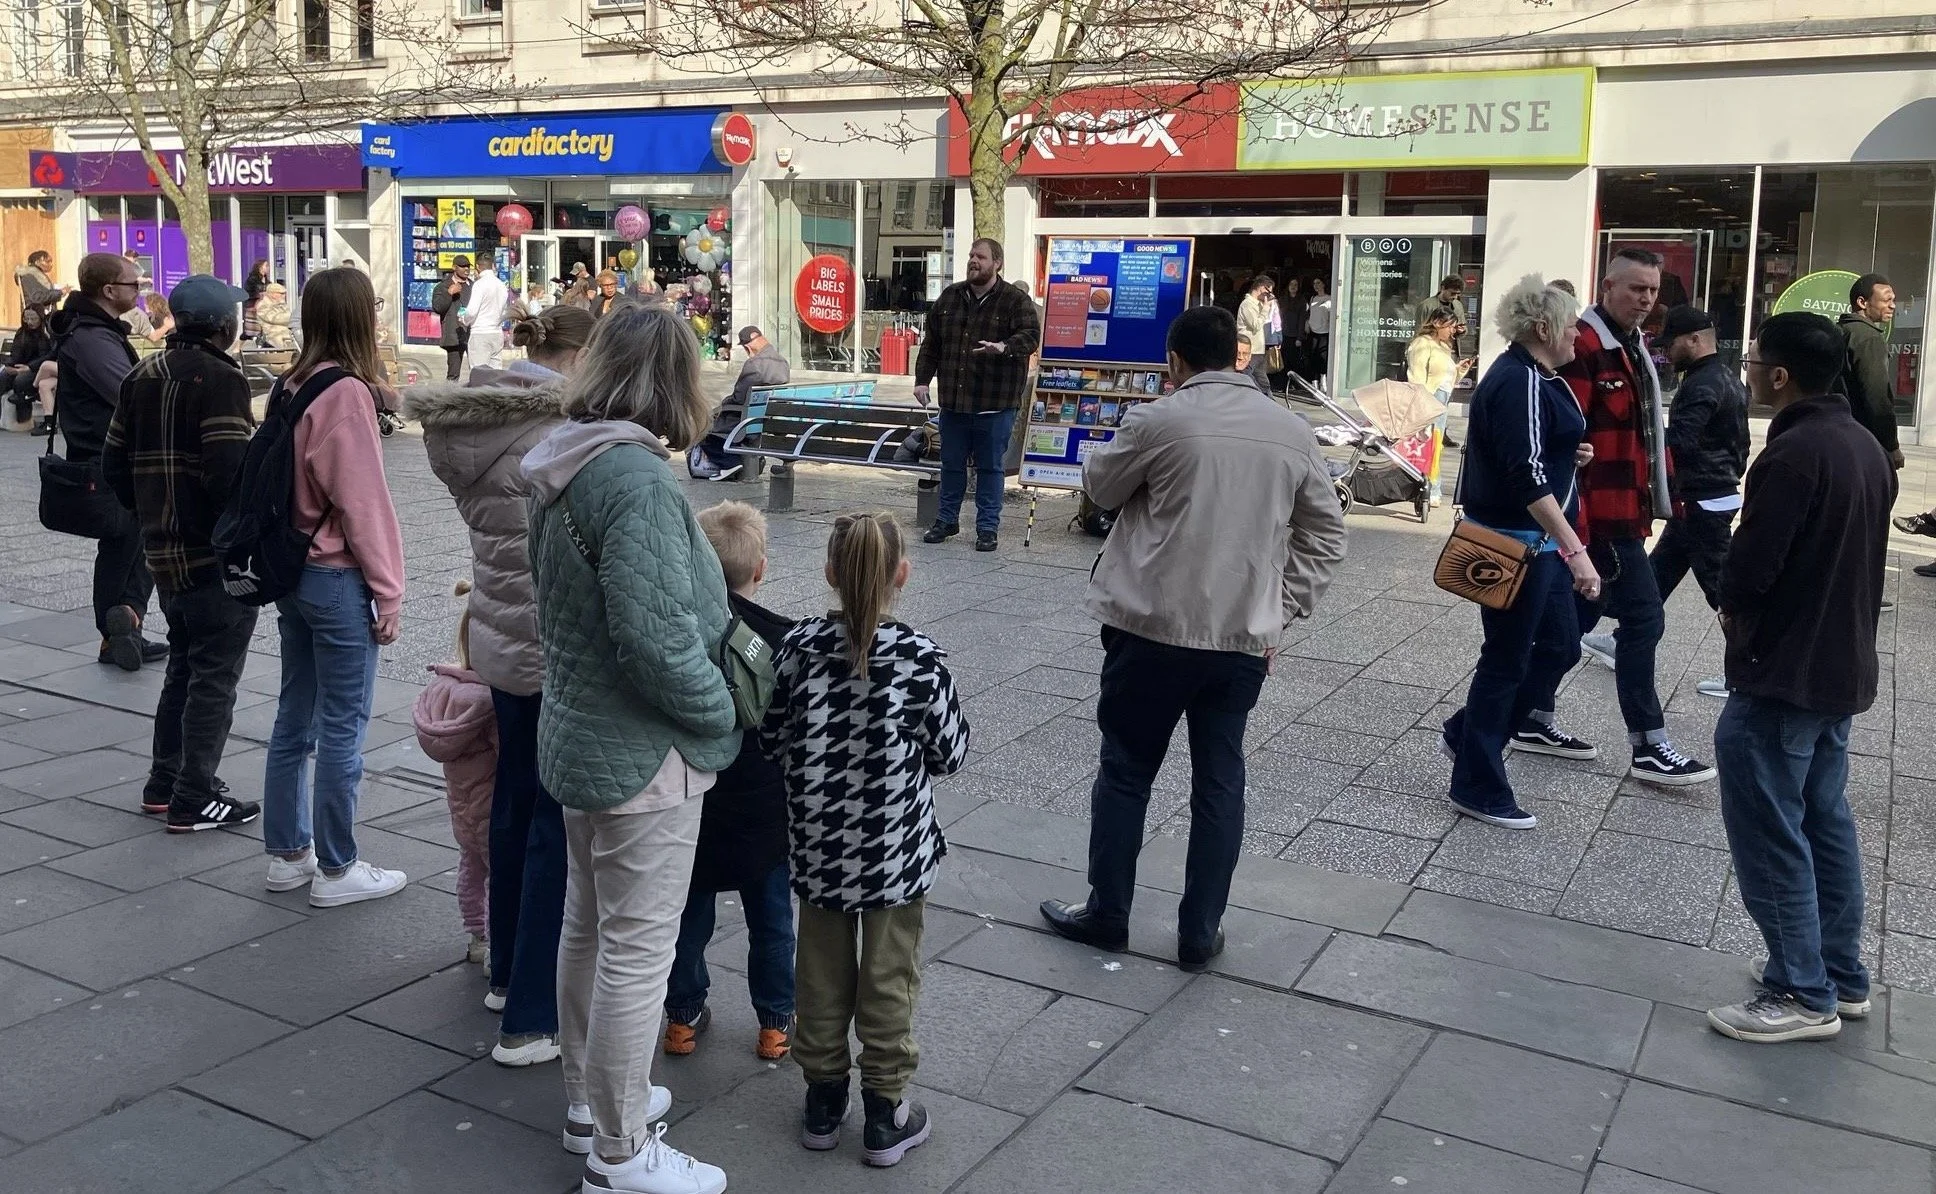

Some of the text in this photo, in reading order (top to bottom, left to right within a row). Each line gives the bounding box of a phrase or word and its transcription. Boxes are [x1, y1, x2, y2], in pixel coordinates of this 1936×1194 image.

[1274, 101, 1551, 138] HOMESENSE
[373, 135, 391, 146] card
[488, 126, 614, 162] cardfactory
[369, 144, 396, 159] factory
[175, 151, 274, 186] NtWest
[451, 200, 472, 219] 15p
[1136, 245, 1154, 253] GOOD
[1360, 258, 1393, 266] Womens
[820, 267, 837, 279] BIG
[811, 279, 845, 293] LABELS
[812, 294, 841, 308] SMALL
[809, 307, 843, 321] PRICES
[1386, 317, 1416, 327] Collect
[1042, 379, 1078, 389] Free leaflets
[744, 634, 765, 662] HXTN
